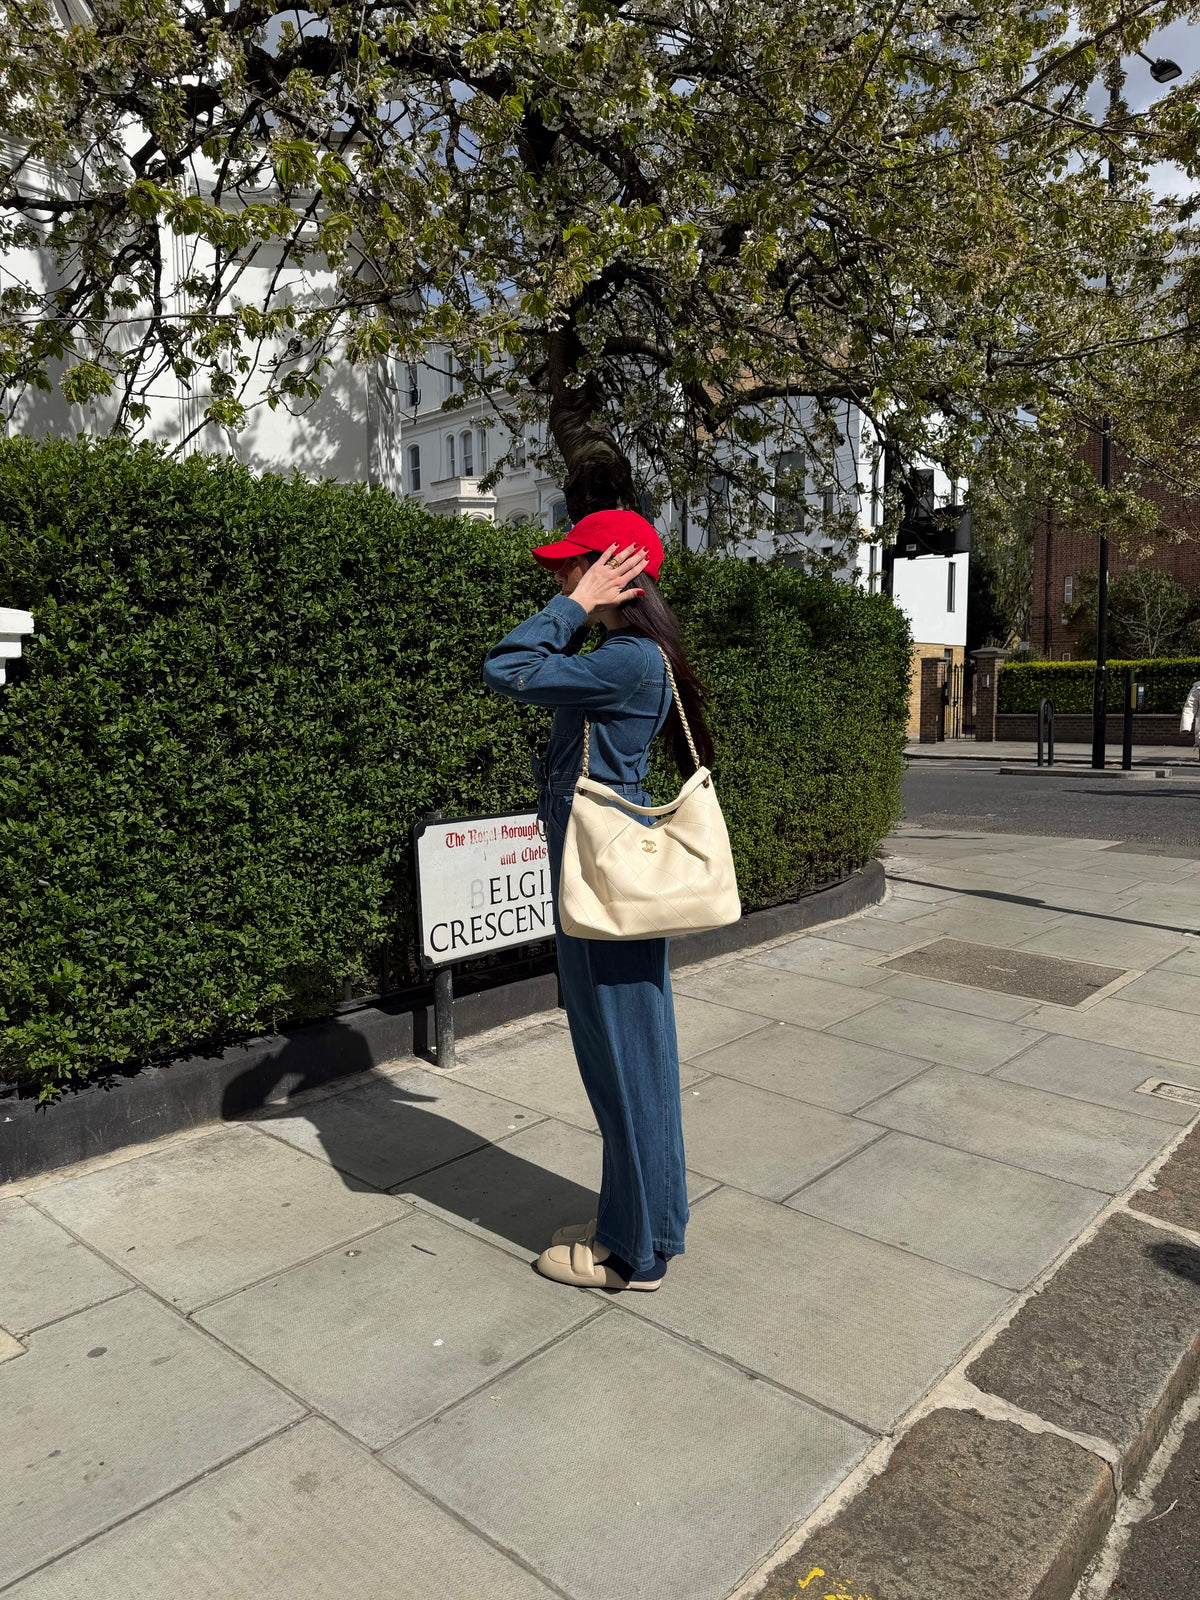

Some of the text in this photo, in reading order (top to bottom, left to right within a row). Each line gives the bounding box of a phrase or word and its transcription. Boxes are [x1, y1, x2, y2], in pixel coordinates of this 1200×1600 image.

[445, 822, 538, 848] The Rol Borough
[500, 845, 548, 865] and Chels
[470, 869, 552, 908] BELGI
